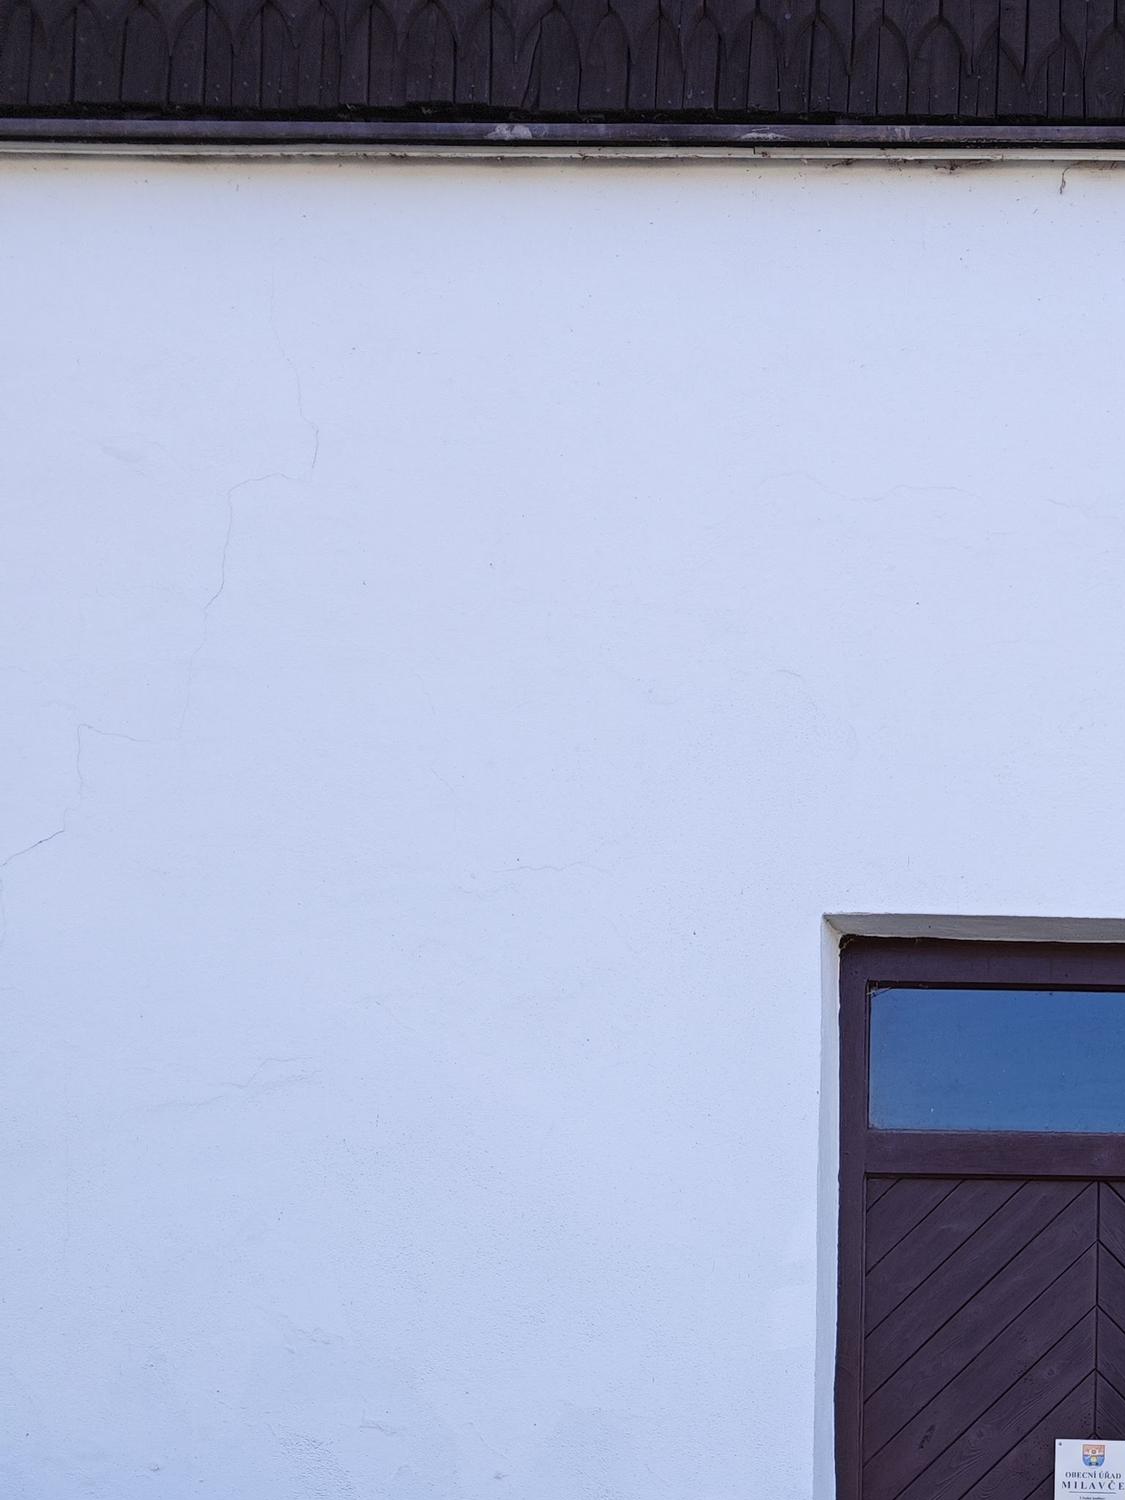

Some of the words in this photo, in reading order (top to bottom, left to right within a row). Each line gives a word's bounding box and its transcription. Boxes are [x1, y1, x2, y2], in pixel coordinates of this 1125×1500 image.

[1065, 1471, 1097, 1479] OBECNÍ
[1098, 1471, 1121, 1479] ÚŘAD
[1061, 1480, 1125, 1490] MILAVČE
